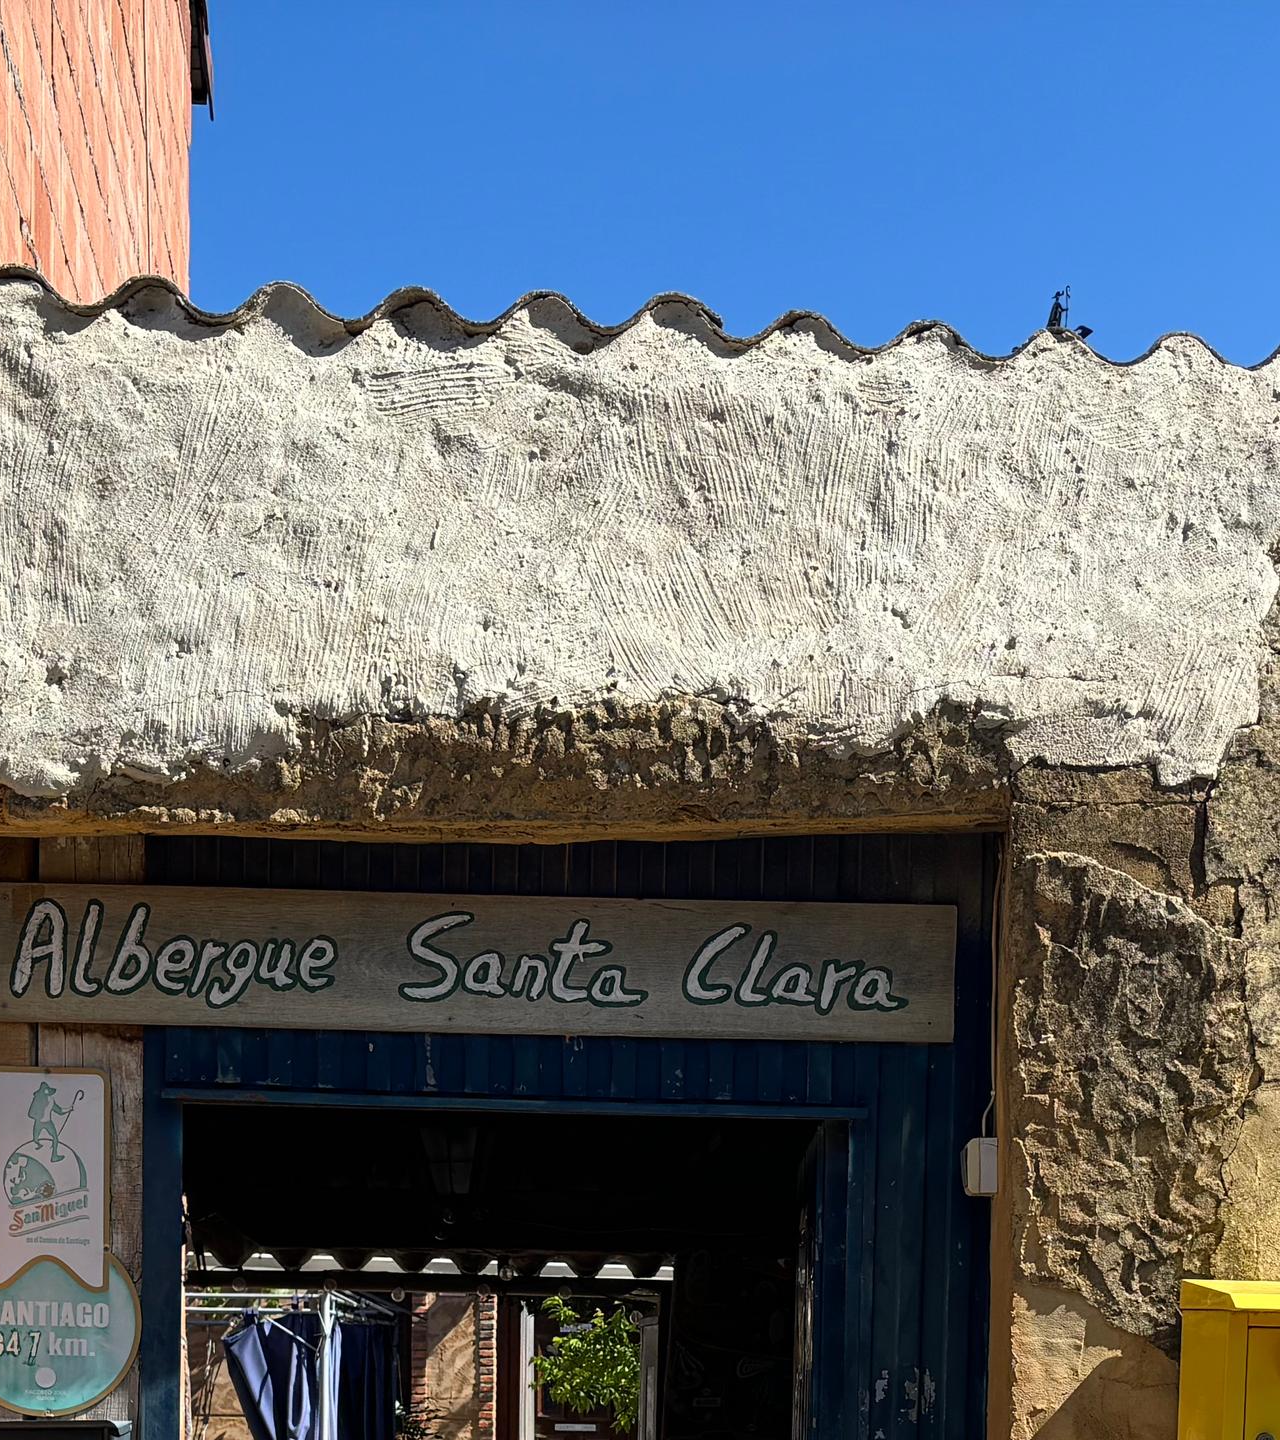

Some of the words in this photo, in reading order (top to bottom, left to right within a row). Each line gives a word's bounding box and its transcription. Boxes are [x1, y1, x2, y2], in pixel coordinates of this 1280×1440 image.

[9, 898, 337, 1008] Albergue
[399, 911, 645, 1004] Santa
[683, 922, 908, 1014] Clara
[36, 1195, 88, 1221] Miguel
[48, 1331, 96, 1357] km.
